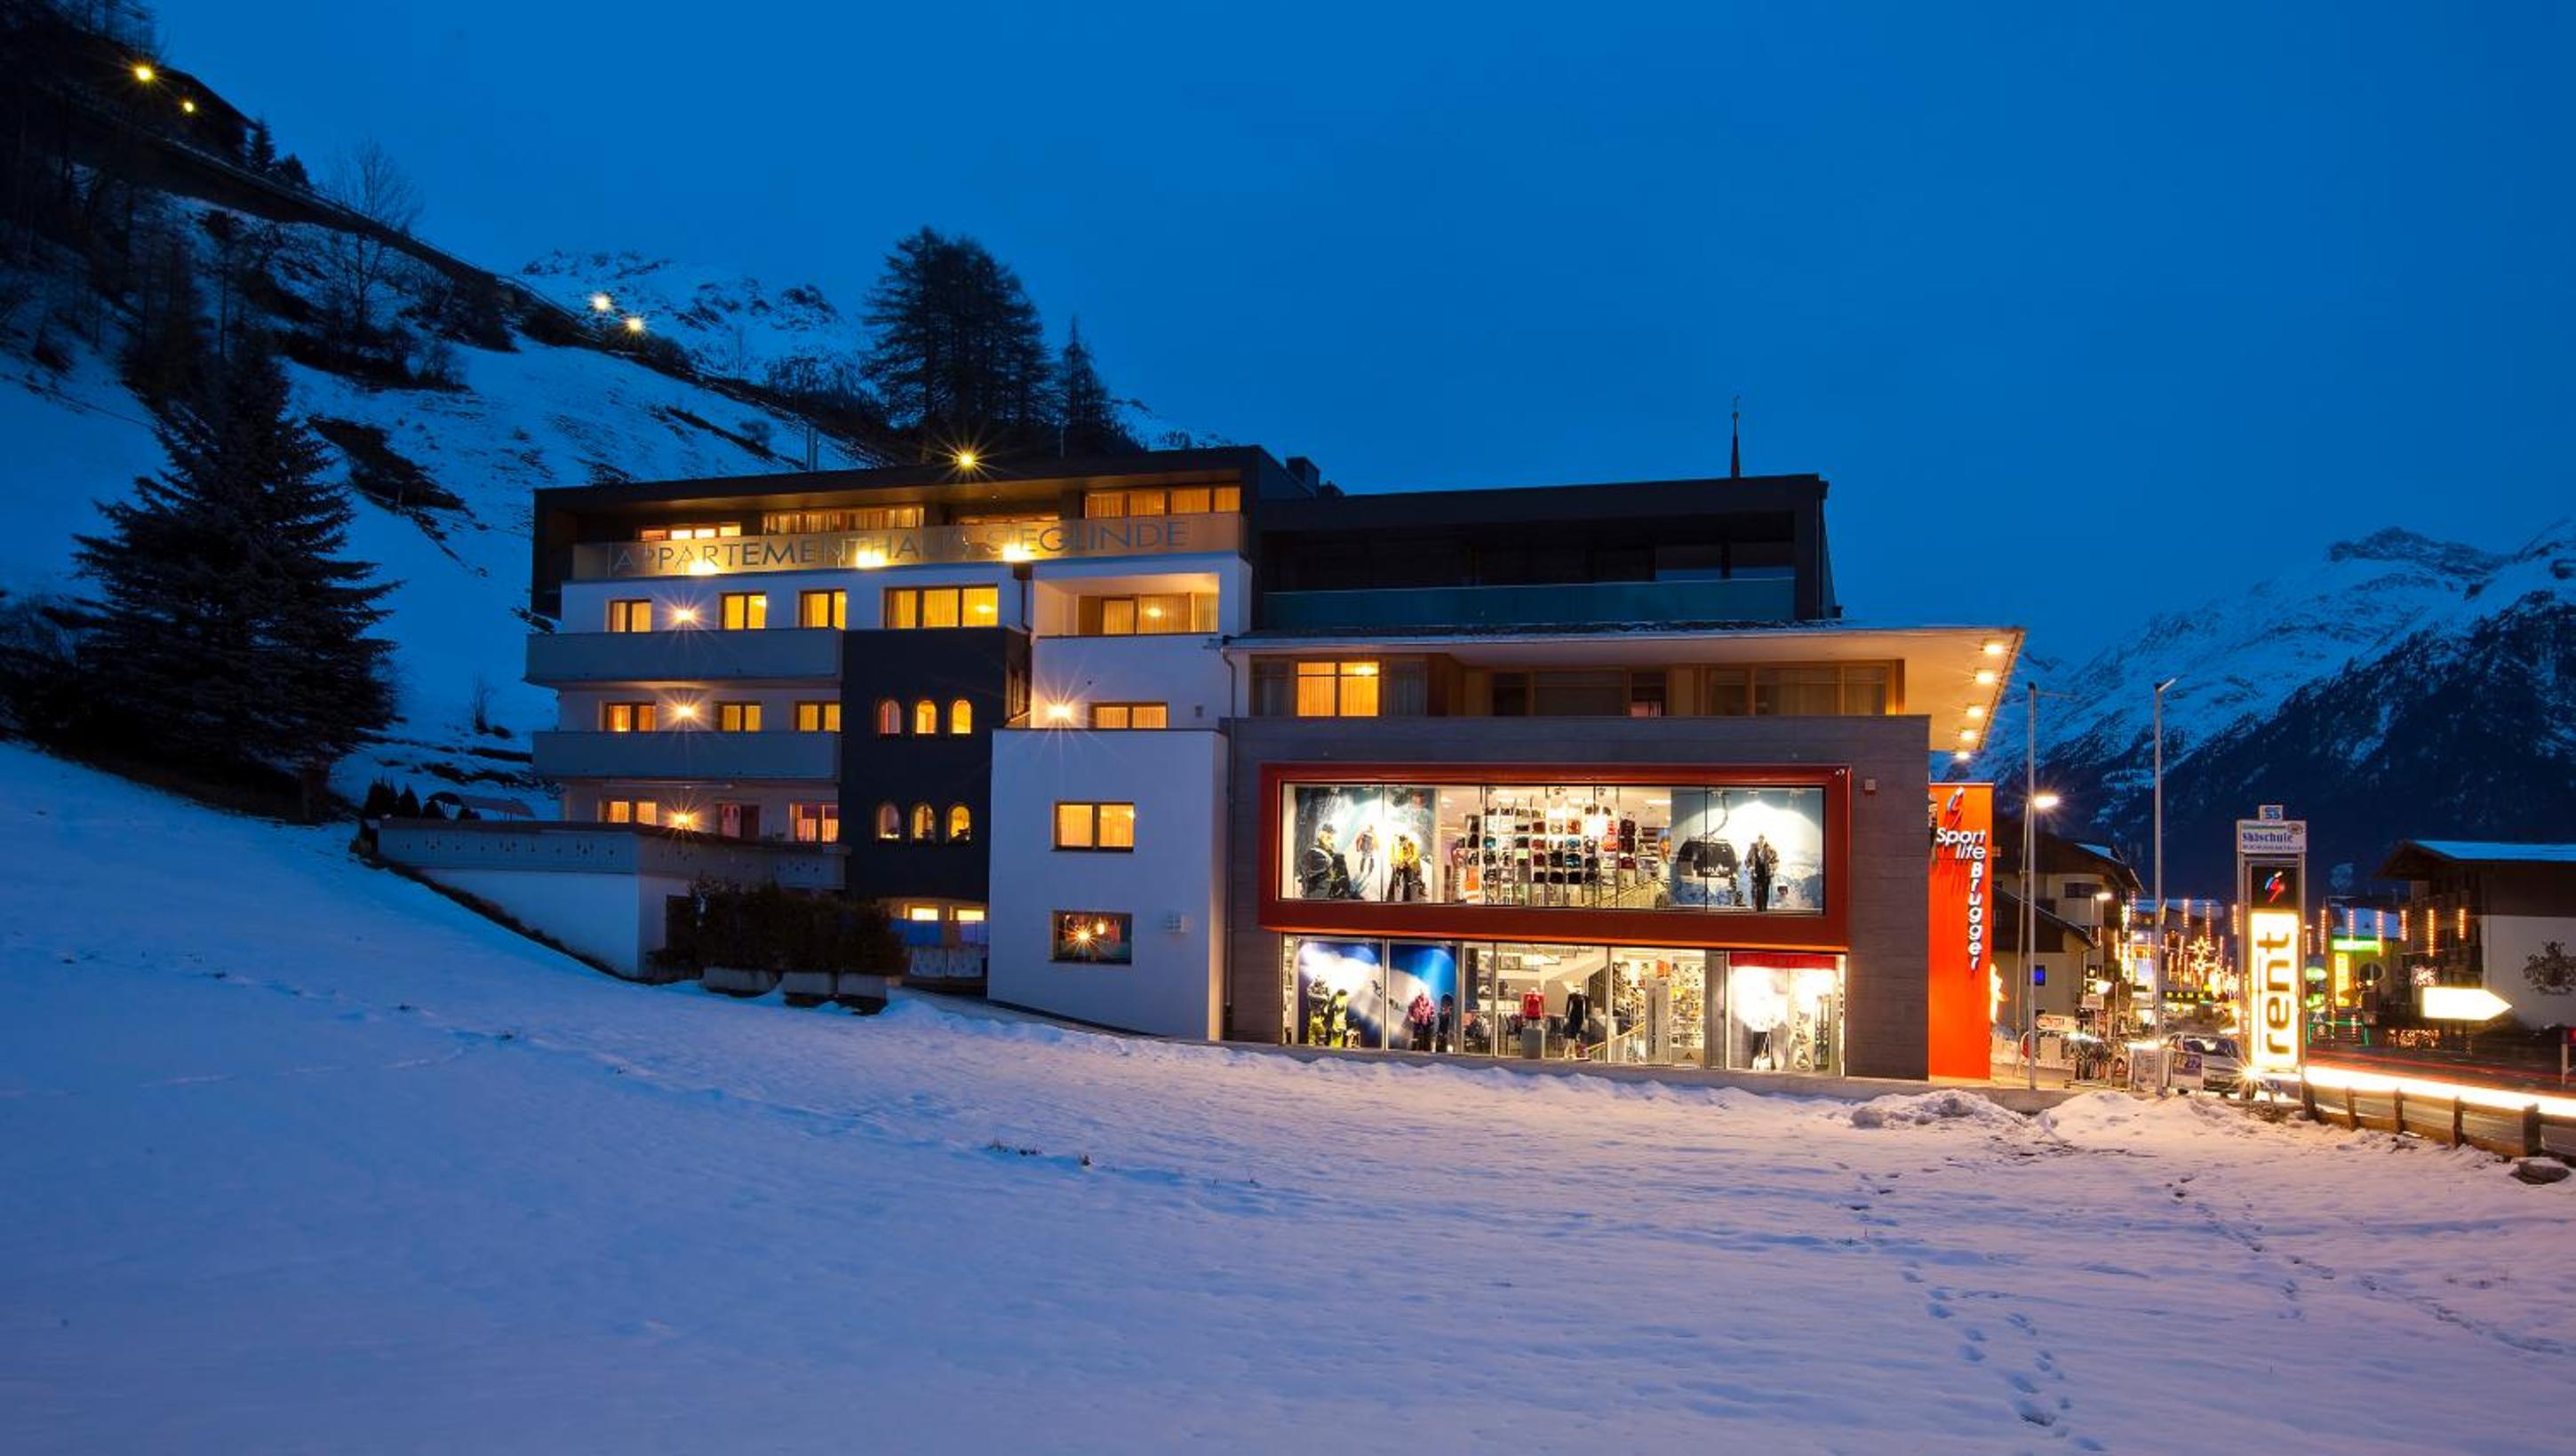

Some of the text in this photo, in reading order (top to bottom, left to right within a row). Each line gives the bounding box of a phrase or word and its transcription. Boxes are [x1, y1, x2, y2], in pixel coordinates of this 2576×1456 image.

[1936, 827, 1986, 846] Sport
[1956, 845, 1986, 859] life
[1968, 862, 1983, 969] Brugger
[2257, 933, 2290, 1054] rent
